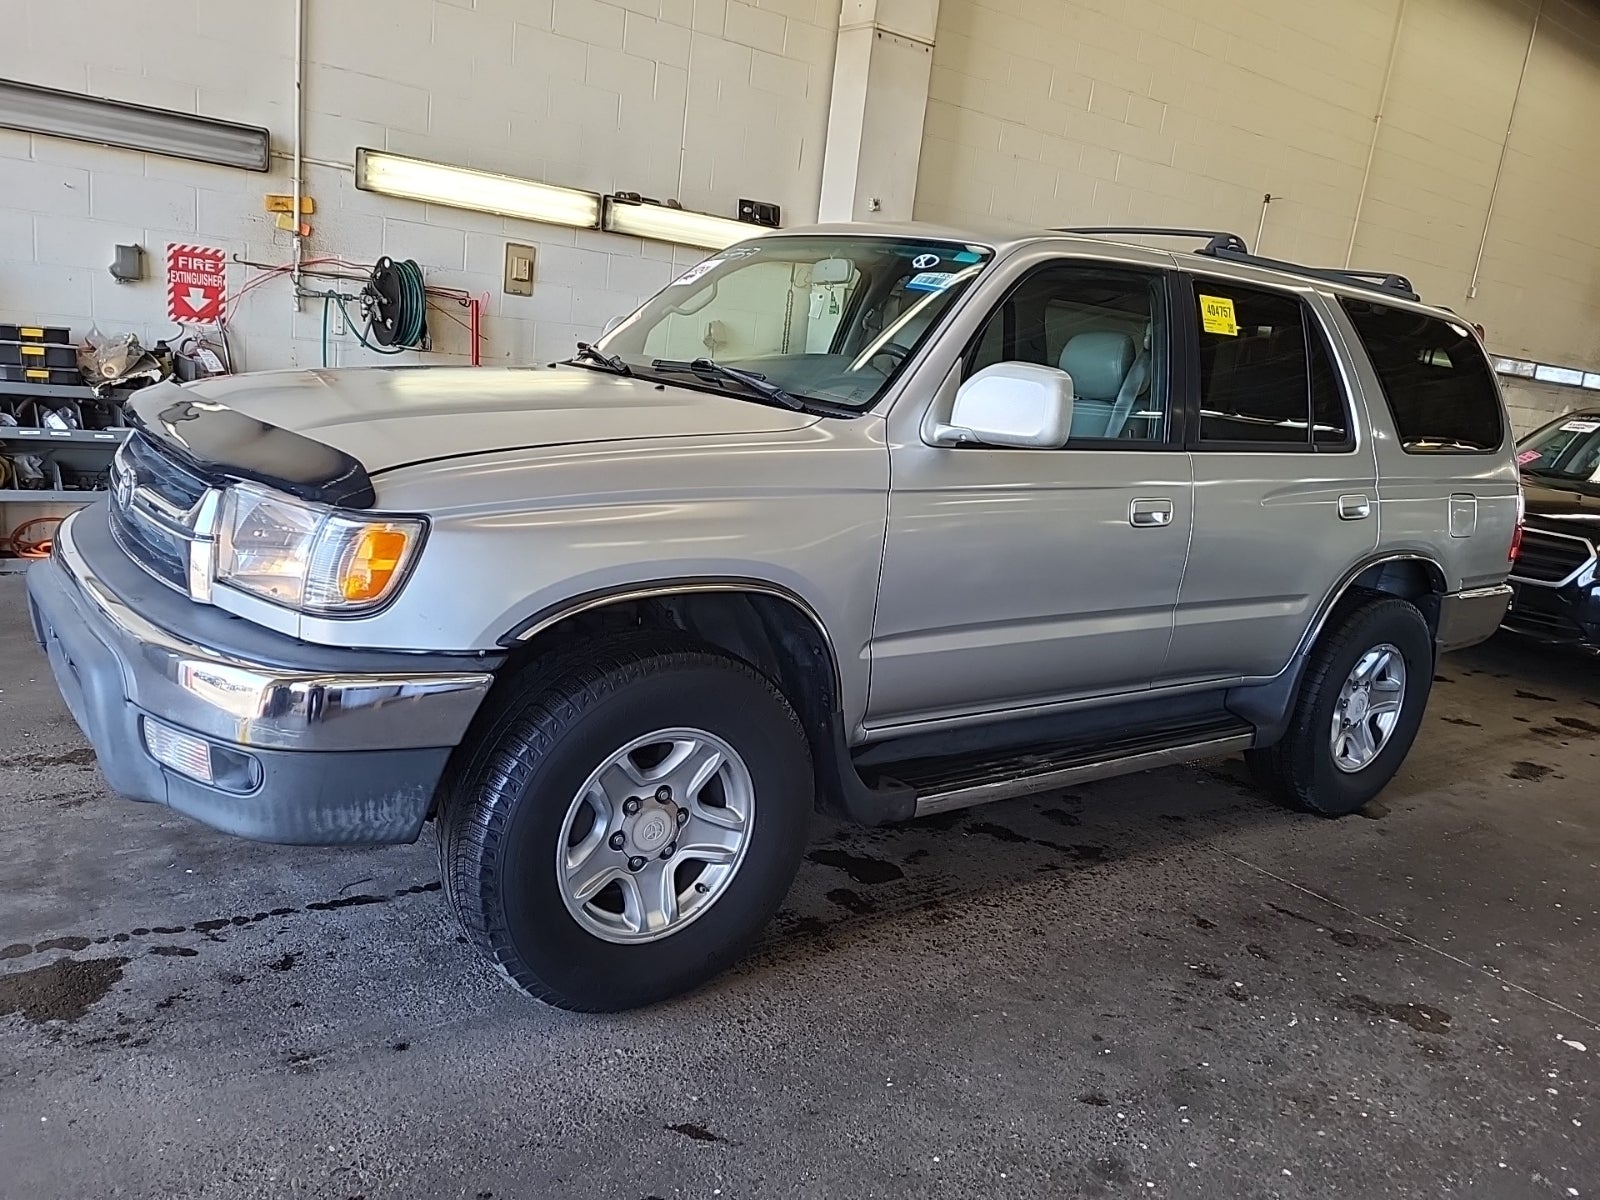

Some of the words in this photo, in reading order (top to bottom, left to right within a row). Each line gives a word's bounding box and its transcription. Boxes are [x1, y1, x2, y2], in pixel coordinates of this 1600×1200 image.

[178, 256, 216, 272] FIRE
[170, 270, 223, 288] EXTINGUISHER
[1207, 303, 1232, 319] 404757
